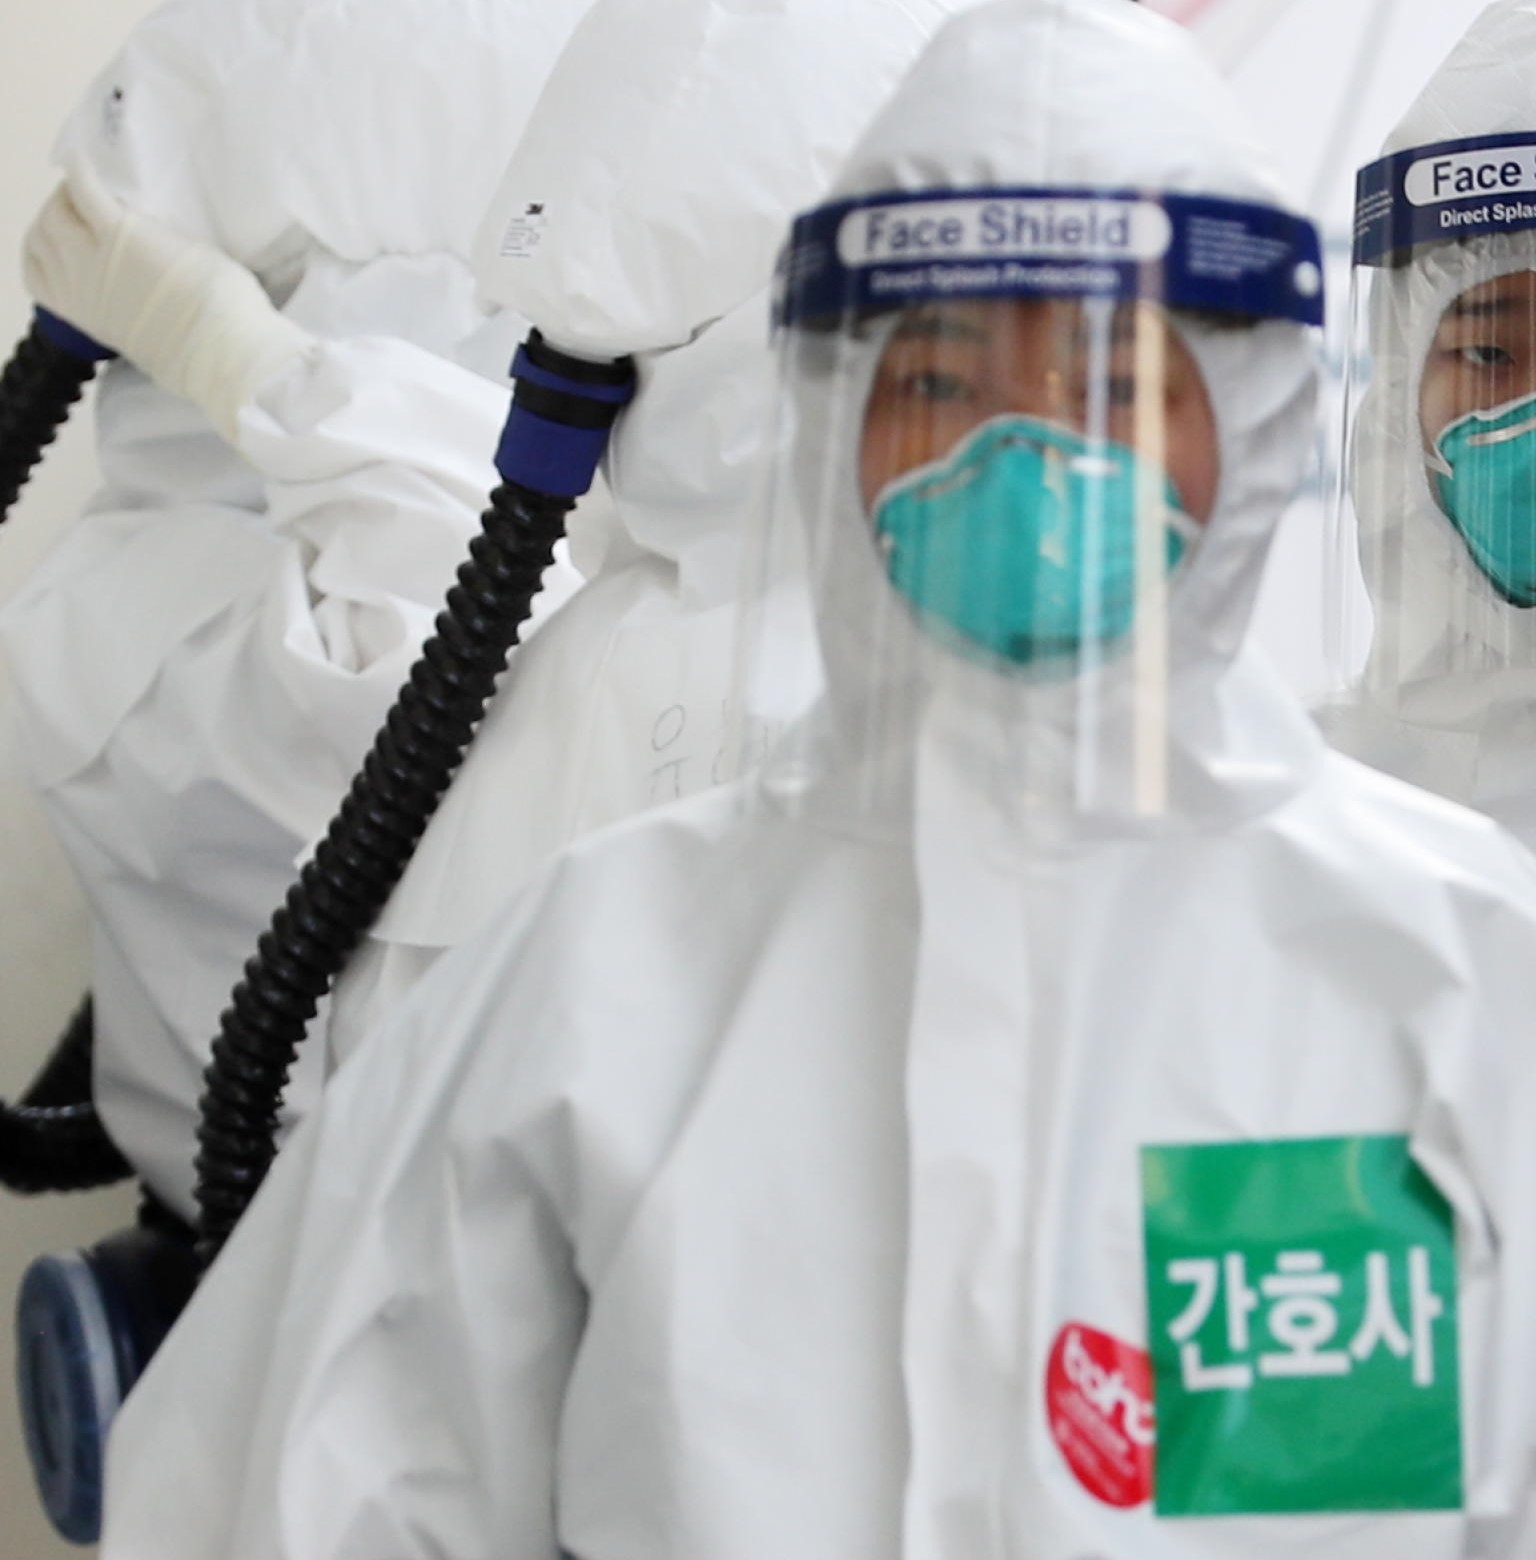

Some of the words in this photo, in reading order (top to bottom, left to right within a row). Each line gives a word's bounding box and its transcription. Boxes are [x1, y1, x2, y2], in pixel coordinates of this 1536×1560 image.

[1433, 160, 1522, 196] Face
[865, 211, 962, 251] Face
[979, 203, 1130, 247] Shield
[1440, 206, 1490, 228] Direct
[1166, 1245, 1444, 1392] 간호사
